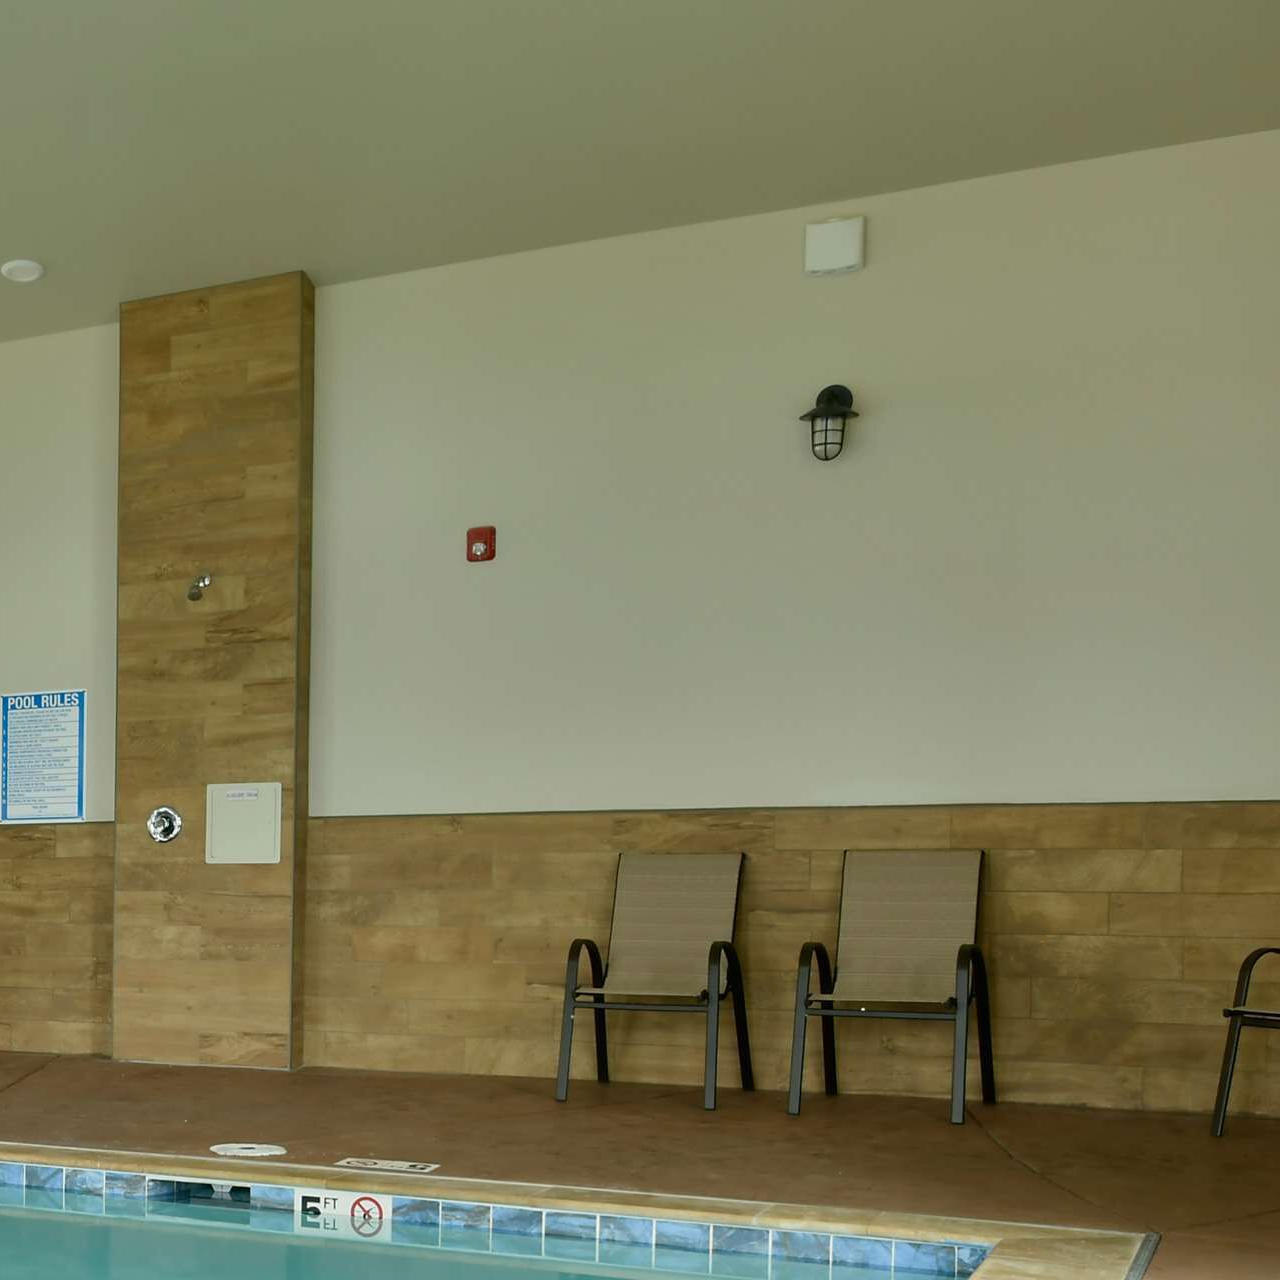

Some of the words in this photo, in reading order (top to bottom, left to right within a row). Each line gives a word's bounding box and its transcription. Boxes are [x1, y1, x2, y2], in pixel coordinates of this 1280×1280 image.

[8, 695, 38, 710] POOL
[41, 692, 79, 708] RULES
[302, 1195, 321, 1220] 5
[323, 1197, 339, 1210] FT
